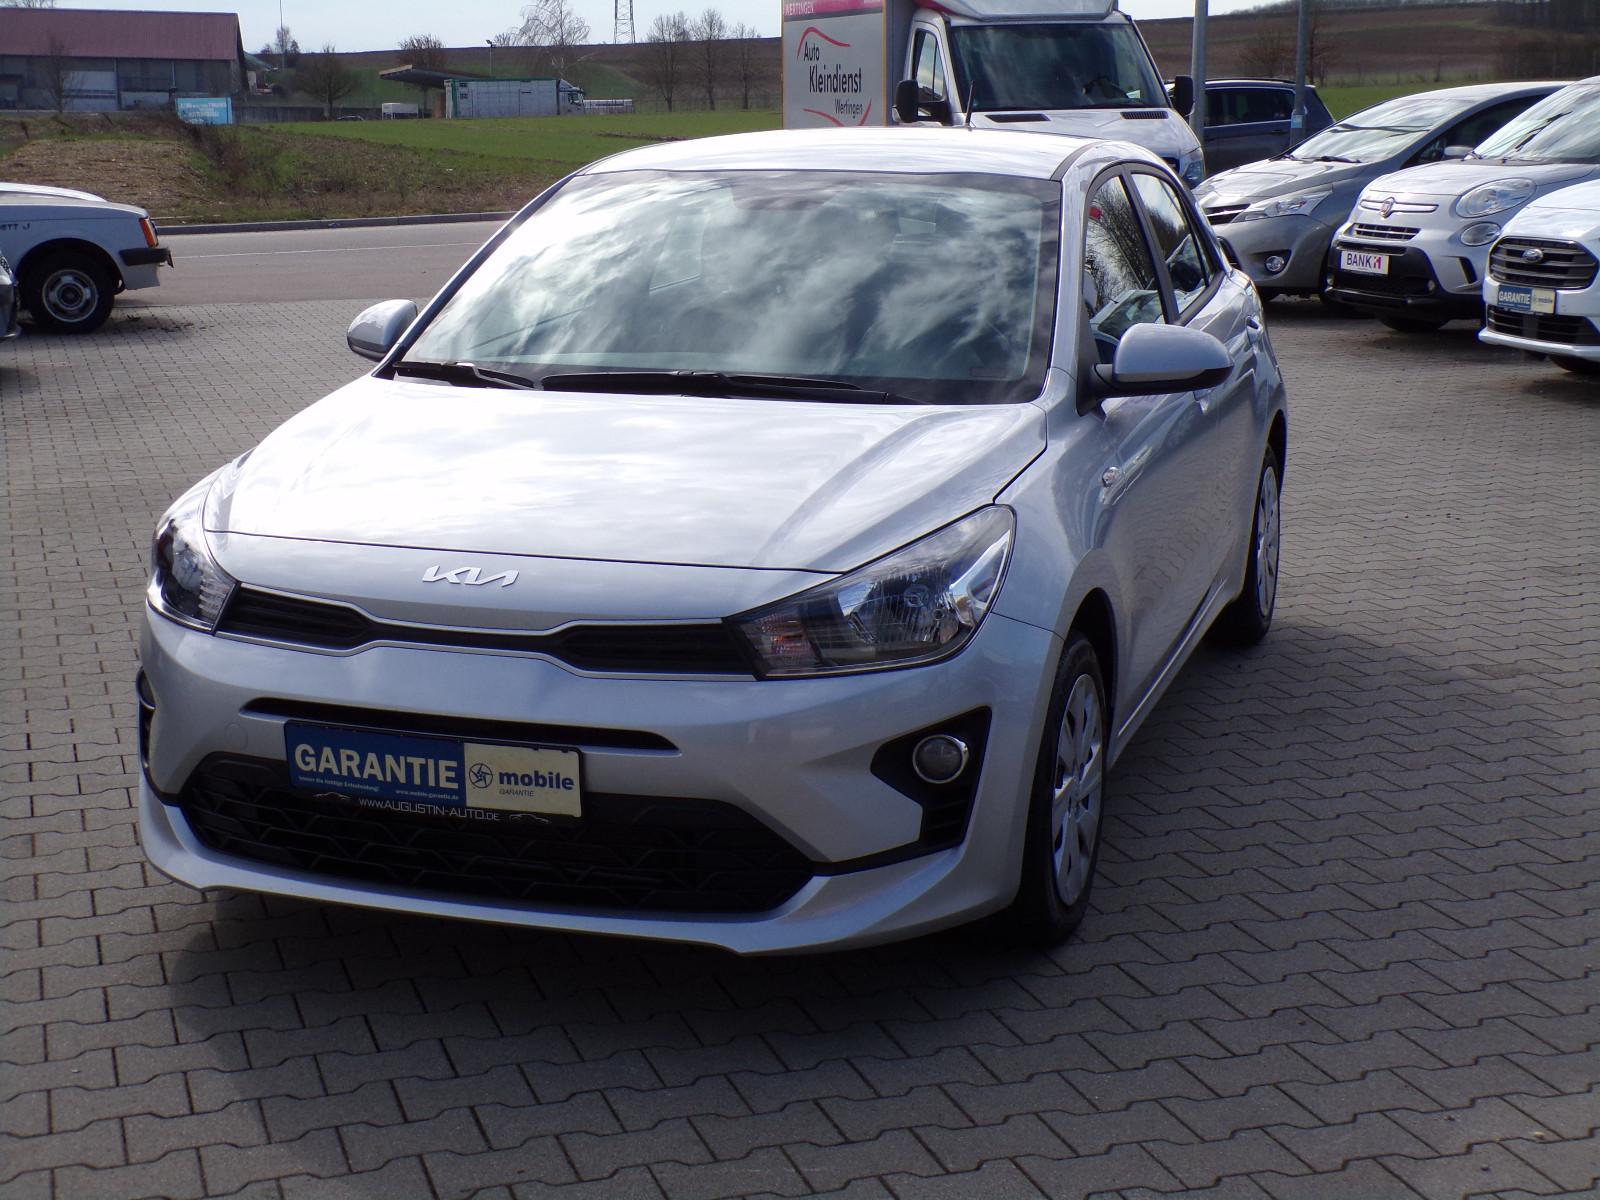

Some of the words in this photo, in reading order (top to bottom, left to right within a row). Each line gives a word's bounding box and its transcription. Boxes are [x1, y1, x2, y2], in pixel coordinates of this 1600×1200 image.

[803, 41, 820, 61] Auto
[809, 63, 862, 93] Kleindienst
[834, 98, 863, 119] Wertingen
[1499, 290, 1531, 305] GARANTIE
[422, 564, 519, 588] KIA
[294, 743, 459, 790] GARANTIE
[499, 770, 575, 791] mobile
[498, 788, 535, 797] GARANTIE
